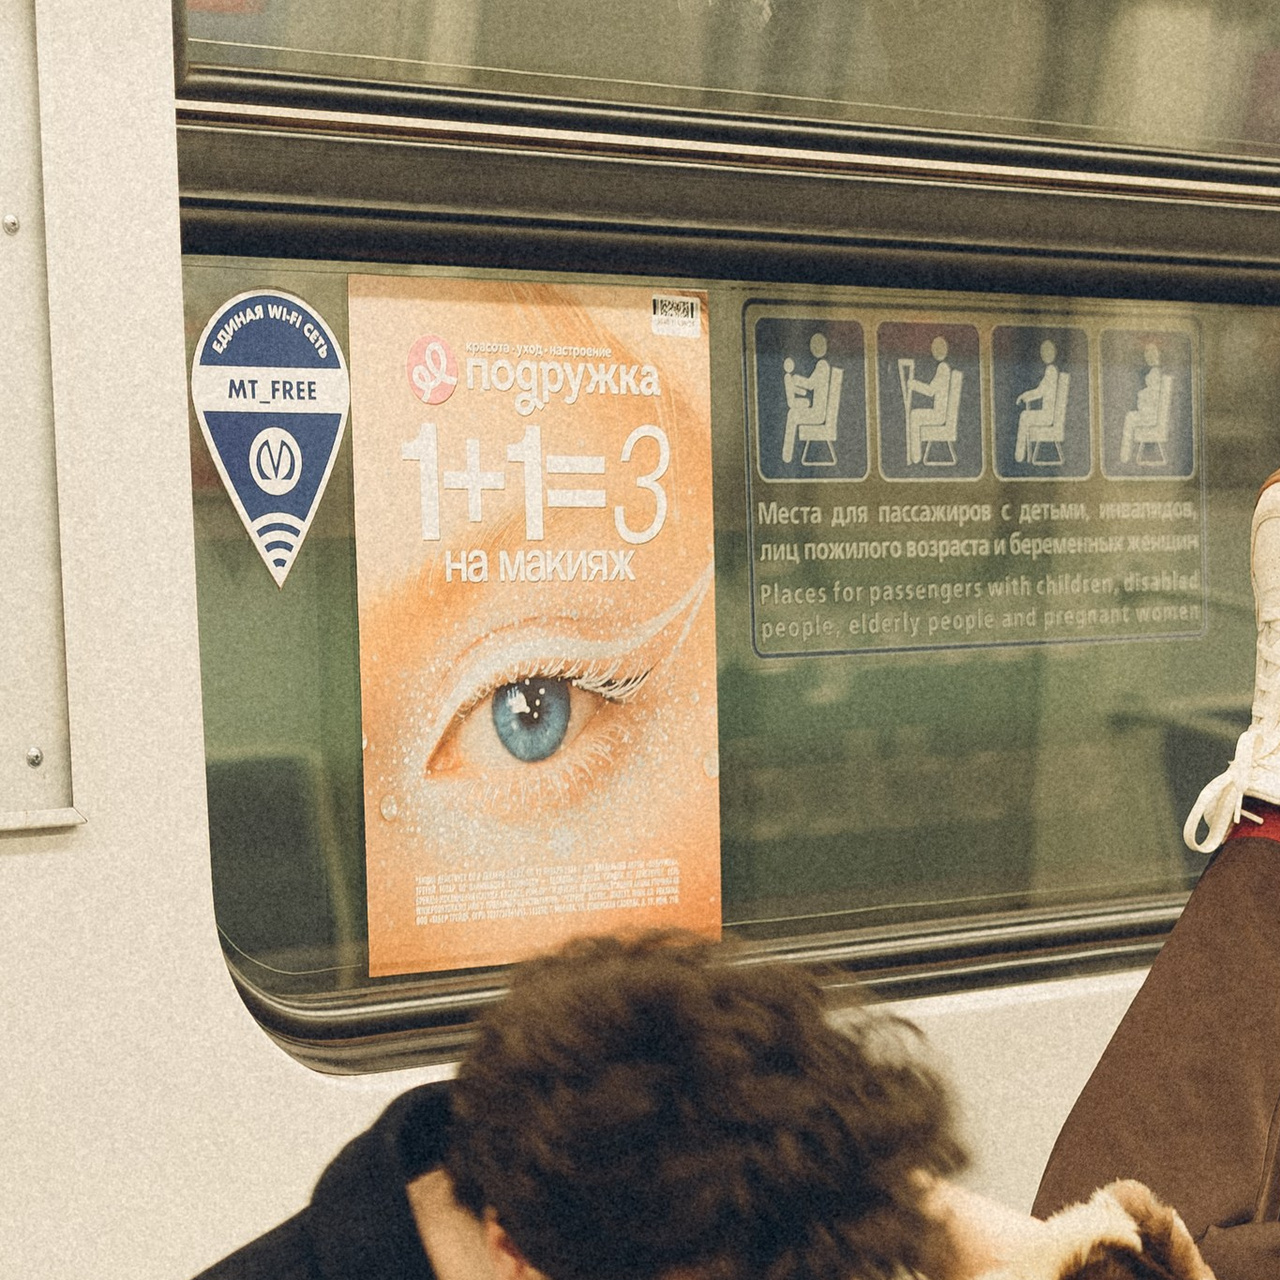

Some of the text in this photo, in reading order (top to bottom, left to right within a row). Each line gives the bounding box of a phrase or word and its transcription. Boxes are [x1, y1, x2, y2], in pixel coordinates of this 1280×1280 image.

[212, 303, 328, 359] ЕДИНАЯ WI-FI СЕТЬ
[465, 342, 612, 358] красота уход настроение
[228, 379, 317, 404] MT_FREE
[466, 358, 662, 416] подружка
[758, 501, 1198, 527] Места для пассажиров с детьми, инвалидов,
[760, 531, 1200, 564] лиц пожилого возраста и беременных женщин
[445, 549, 636, 582] на макияж
[760, 569, 1200, 606] Places for passengers with children, disabled
[762, 604, 1200, 641] people, elderly people and pregnant women
